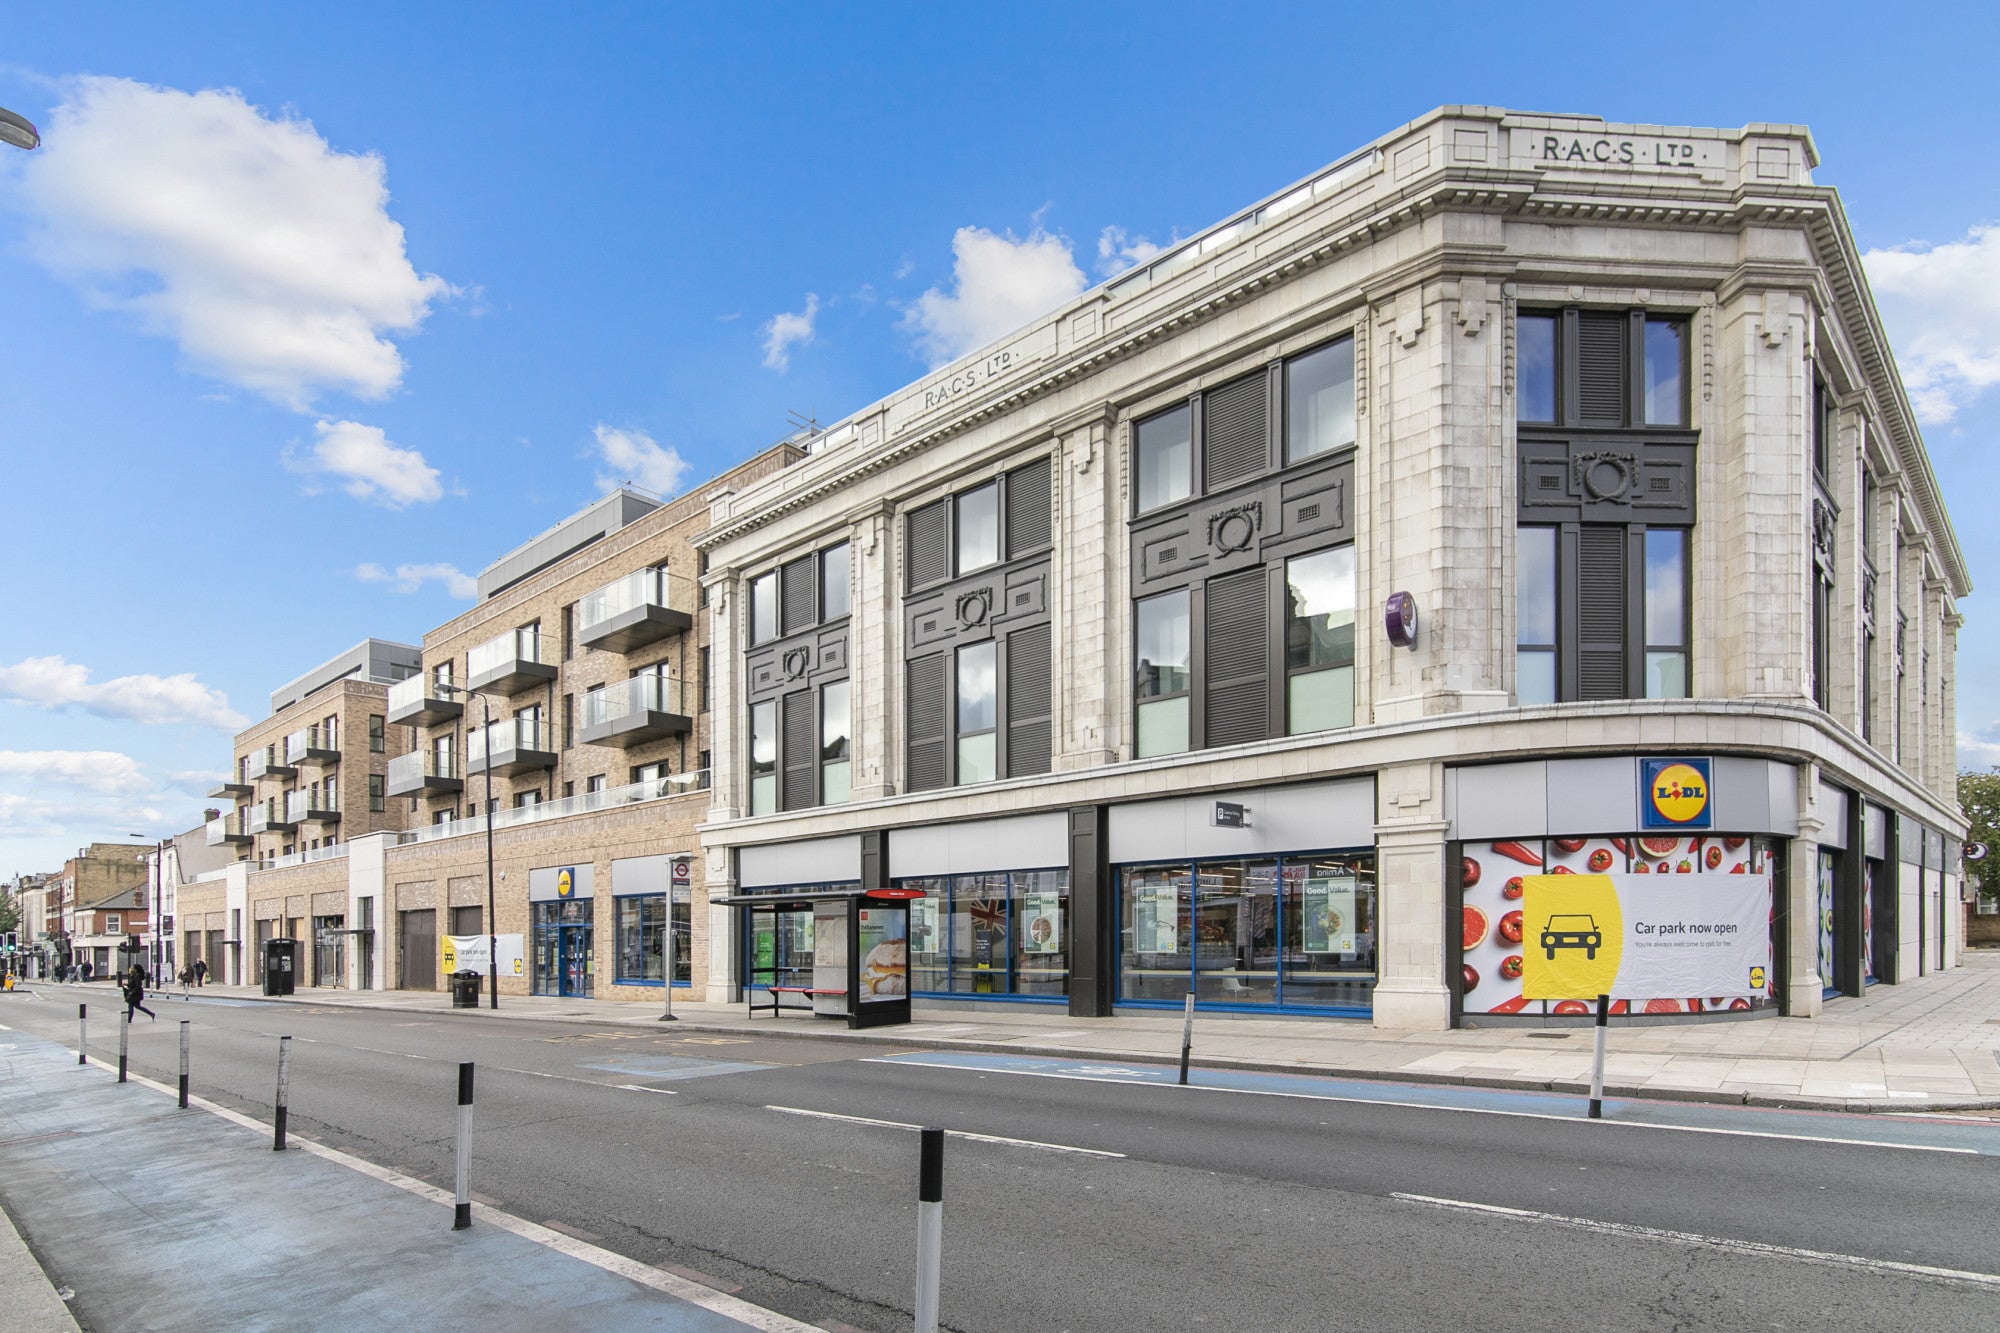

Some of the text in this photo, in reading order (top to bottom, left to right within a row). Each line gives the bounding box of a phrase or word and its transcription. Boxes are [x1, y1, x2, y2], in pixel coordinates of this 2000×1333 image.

[1634, 922, 1738, 936] Car park now open
[1654, 941, 1672, 949] always
